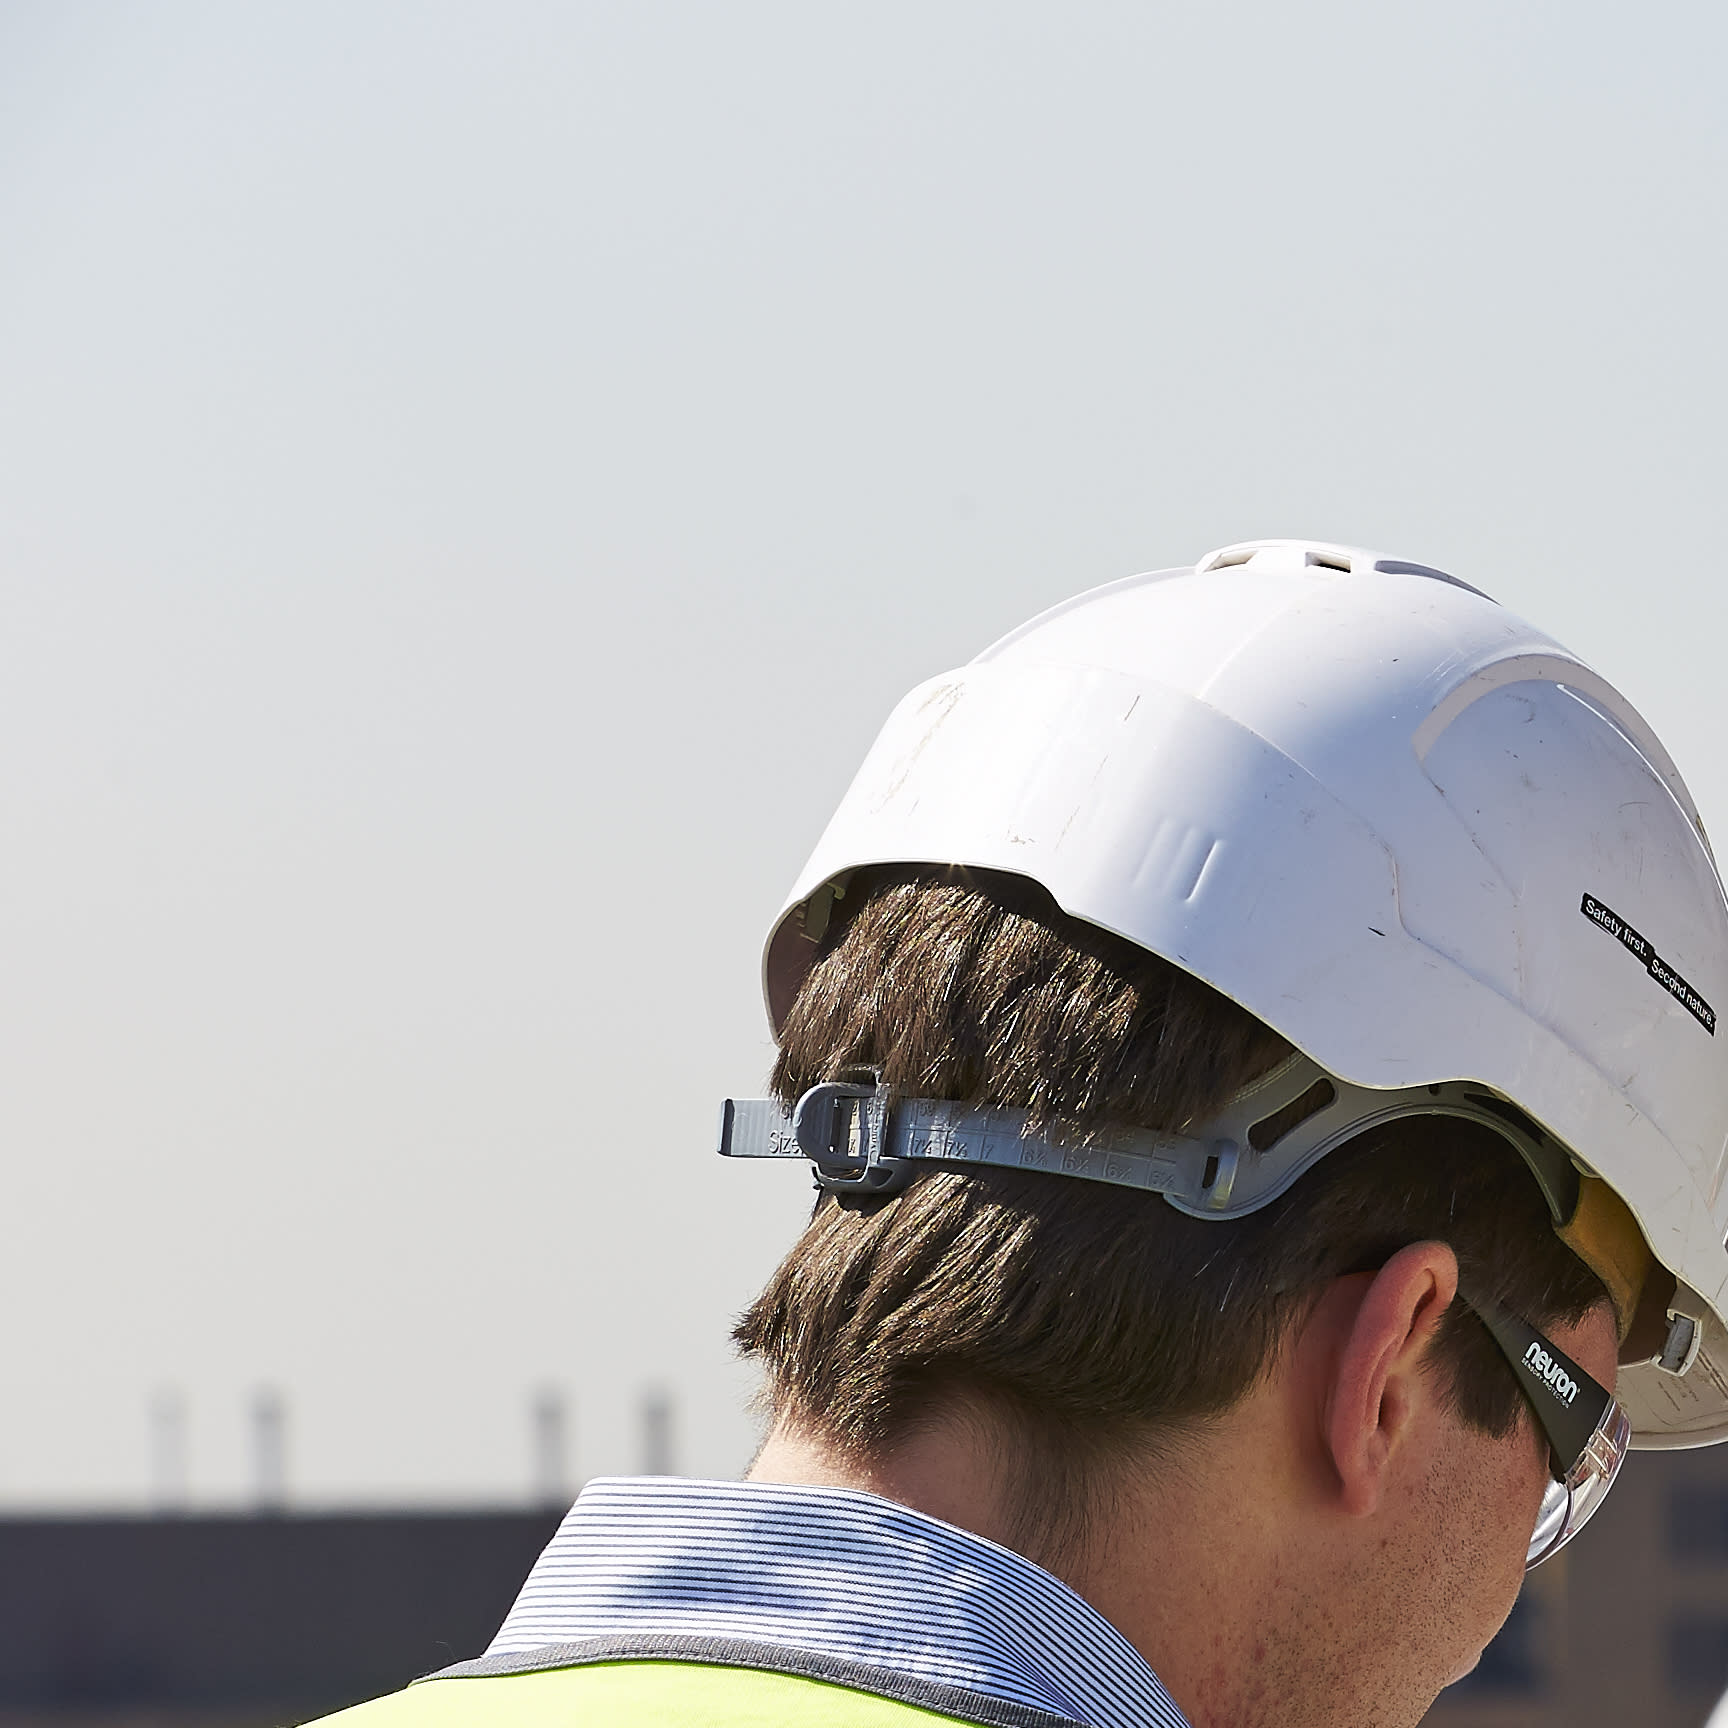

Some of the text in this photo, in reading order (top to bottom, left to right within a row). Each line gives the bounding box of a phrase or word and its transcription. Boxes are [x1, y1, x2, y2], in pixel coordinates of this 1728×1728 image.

[1584, 898, 1714, 1029] Safety first. Second nature.
[1524, 1341, 1579, 1404] neuron
